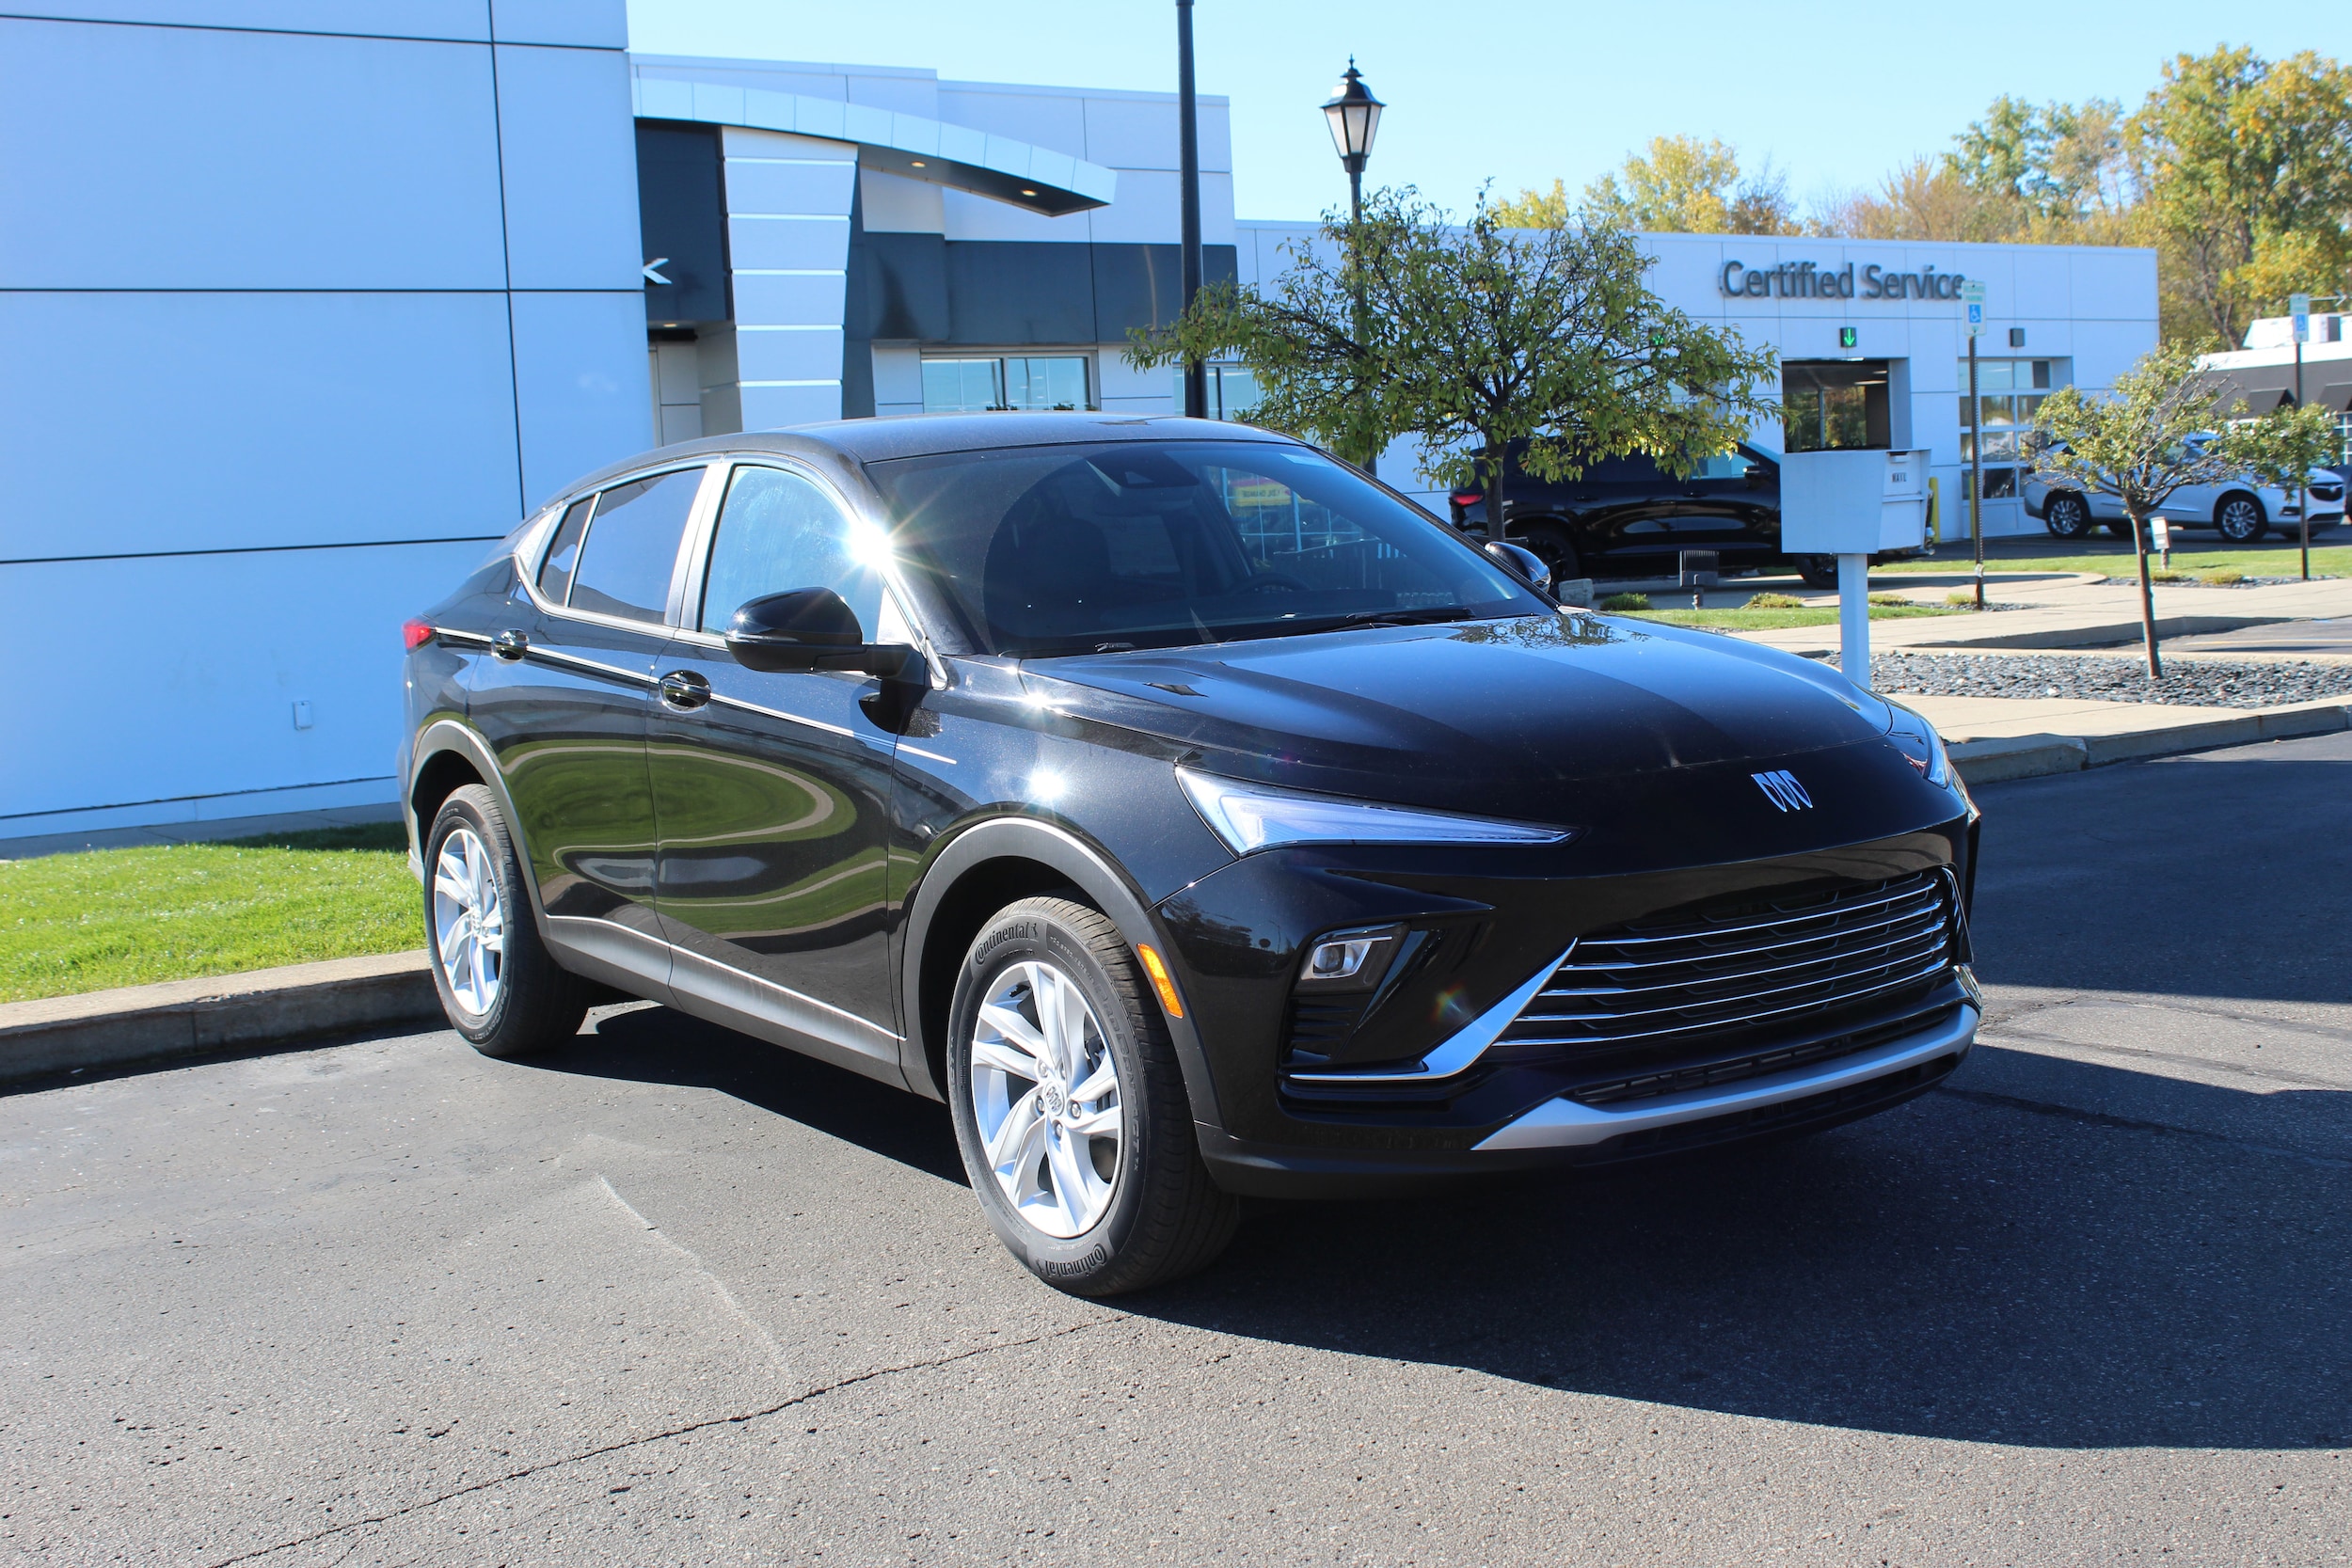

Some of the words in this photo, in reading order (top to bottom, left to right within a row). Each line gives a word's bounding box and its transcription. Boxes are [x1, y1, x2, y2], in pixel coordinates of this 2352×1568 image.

[1722, 260, 1854, 298] Certified
[1862, 263, 1964, 299] Service
[1892, 472, 1907, 483] MAIL
[975, 922, 1029, 965] Continental
[1045, 1243, 1108, 1277] Continental
